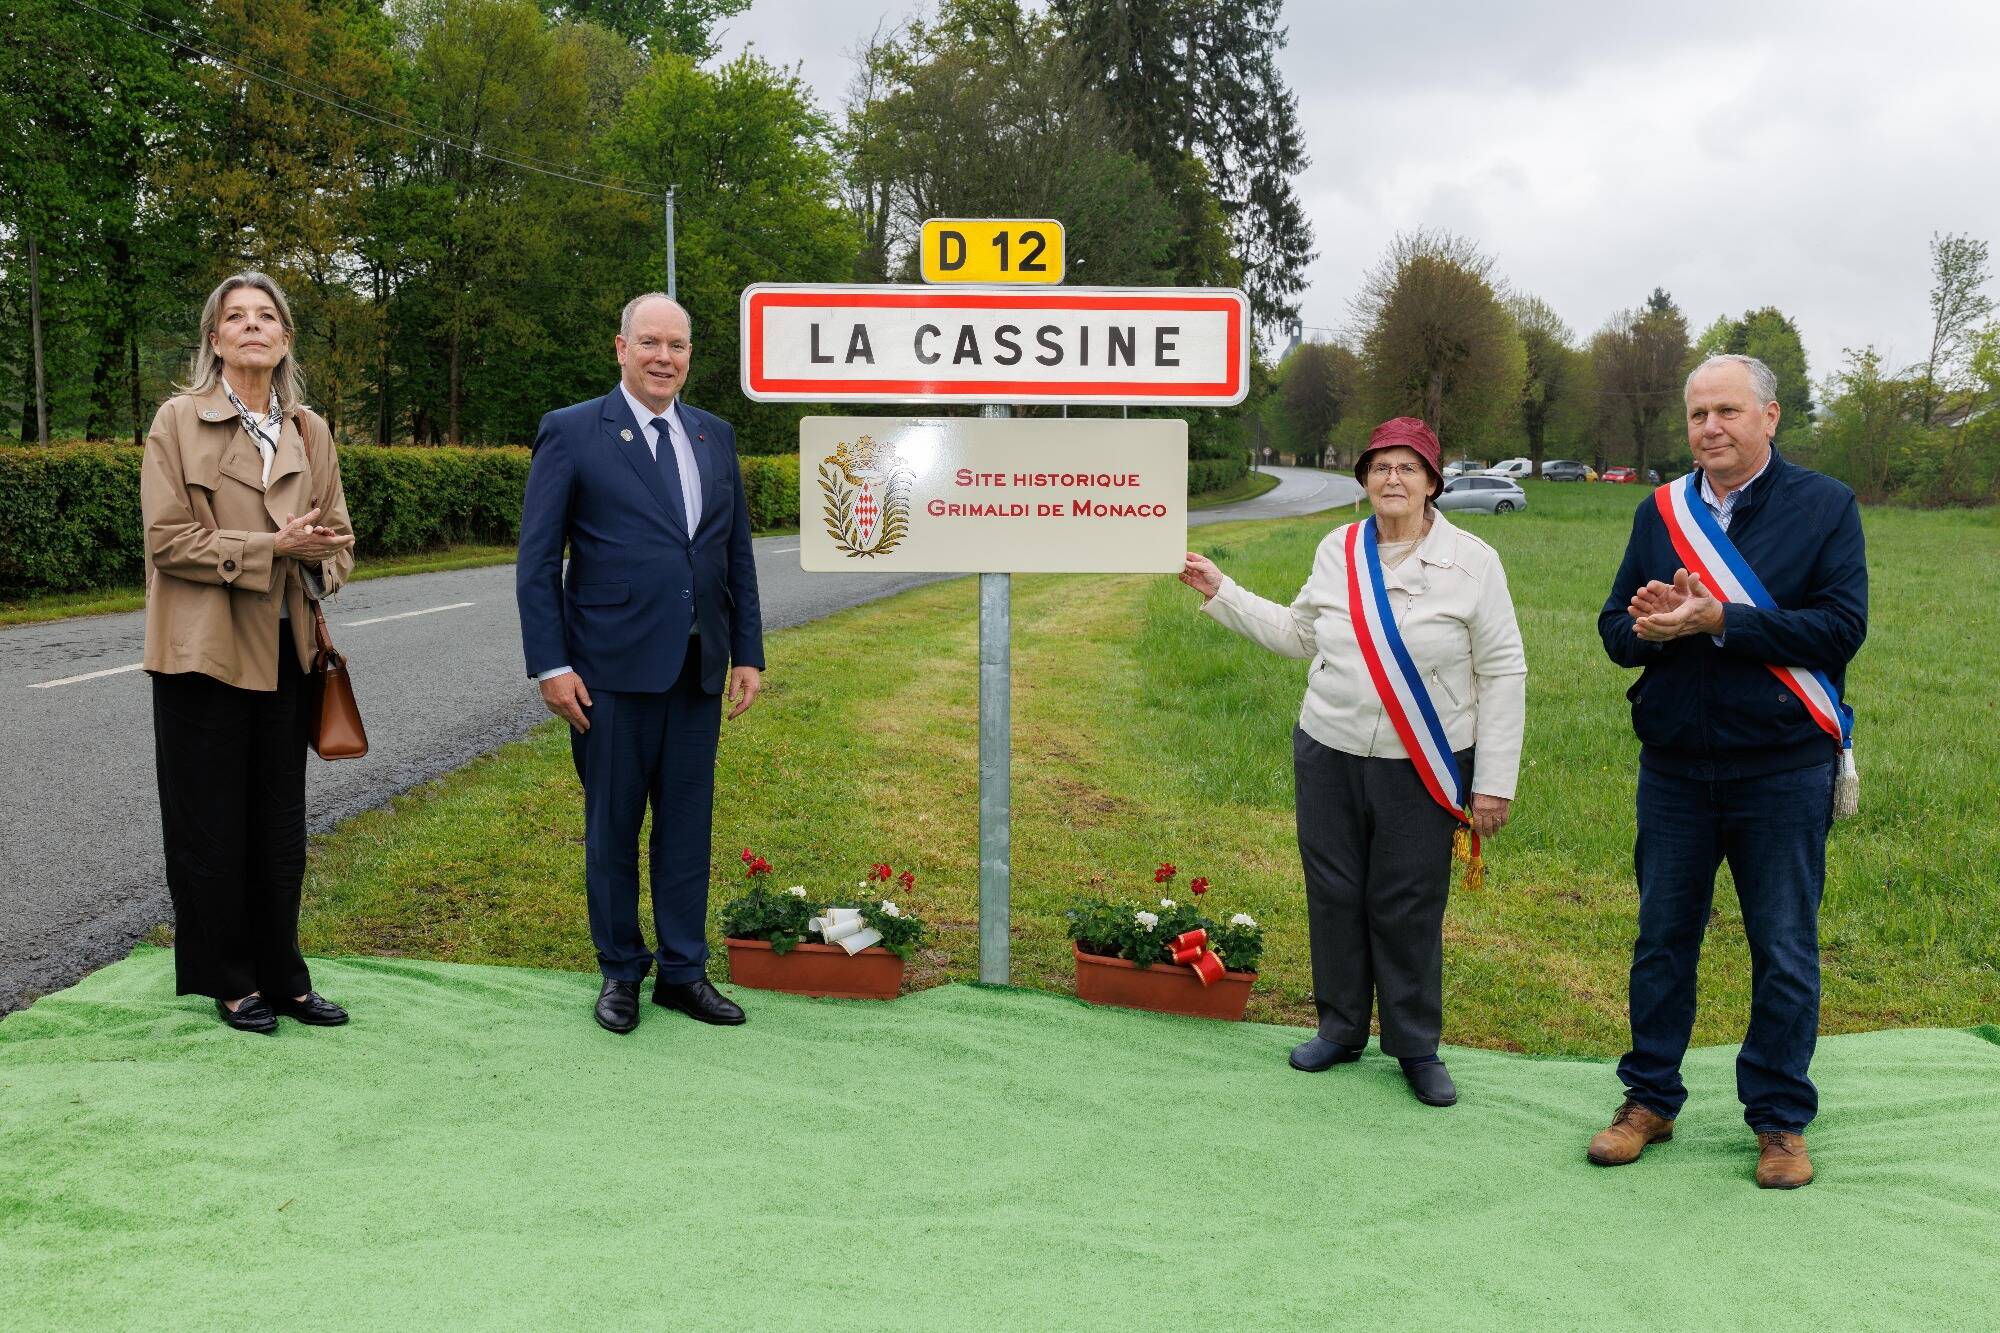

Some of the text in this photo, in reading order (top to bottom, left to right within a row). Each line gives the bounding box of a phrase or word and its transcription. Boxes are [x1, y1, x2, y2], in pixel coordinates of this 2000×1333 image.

[939, 230, 1047, 272] D 12
[810, 323, 1180, 367] LA CASSINE
